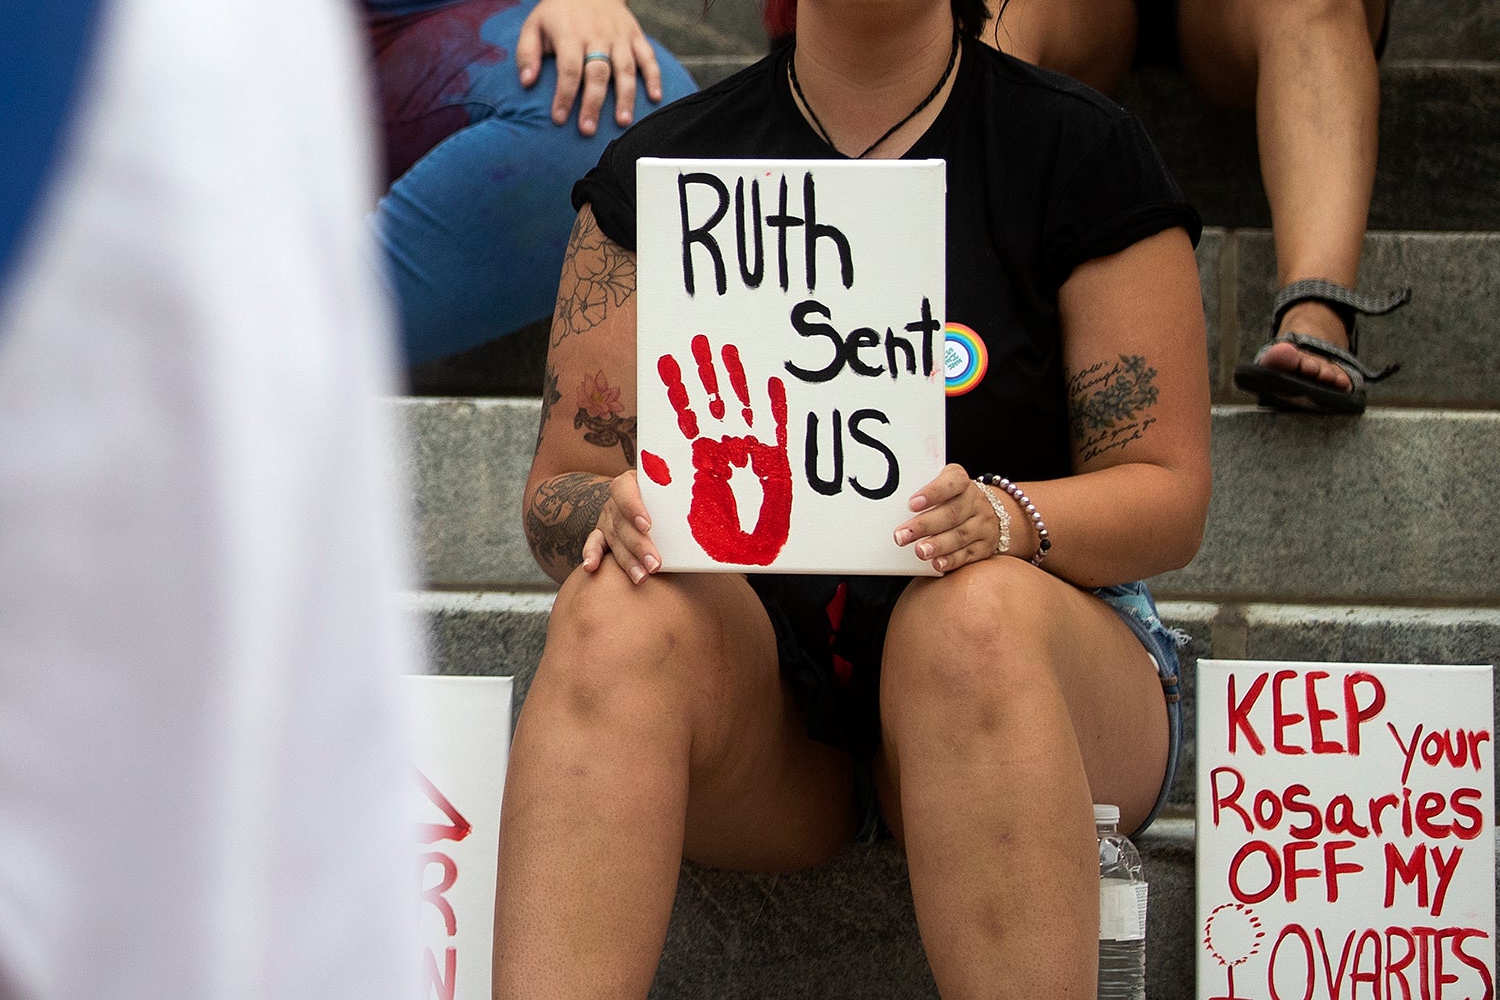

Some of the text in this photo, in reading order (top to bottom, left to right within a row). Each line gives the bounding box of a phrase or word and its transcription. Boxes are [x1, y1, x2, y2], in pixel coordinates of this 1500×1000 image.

[784, 296, 941, 383] Sent
[1227, 669, 1490, 785] KEEP your
[1210, 766, 1484, 840] Rosaries
[1228, 840, 1463, 917] OFF MY
